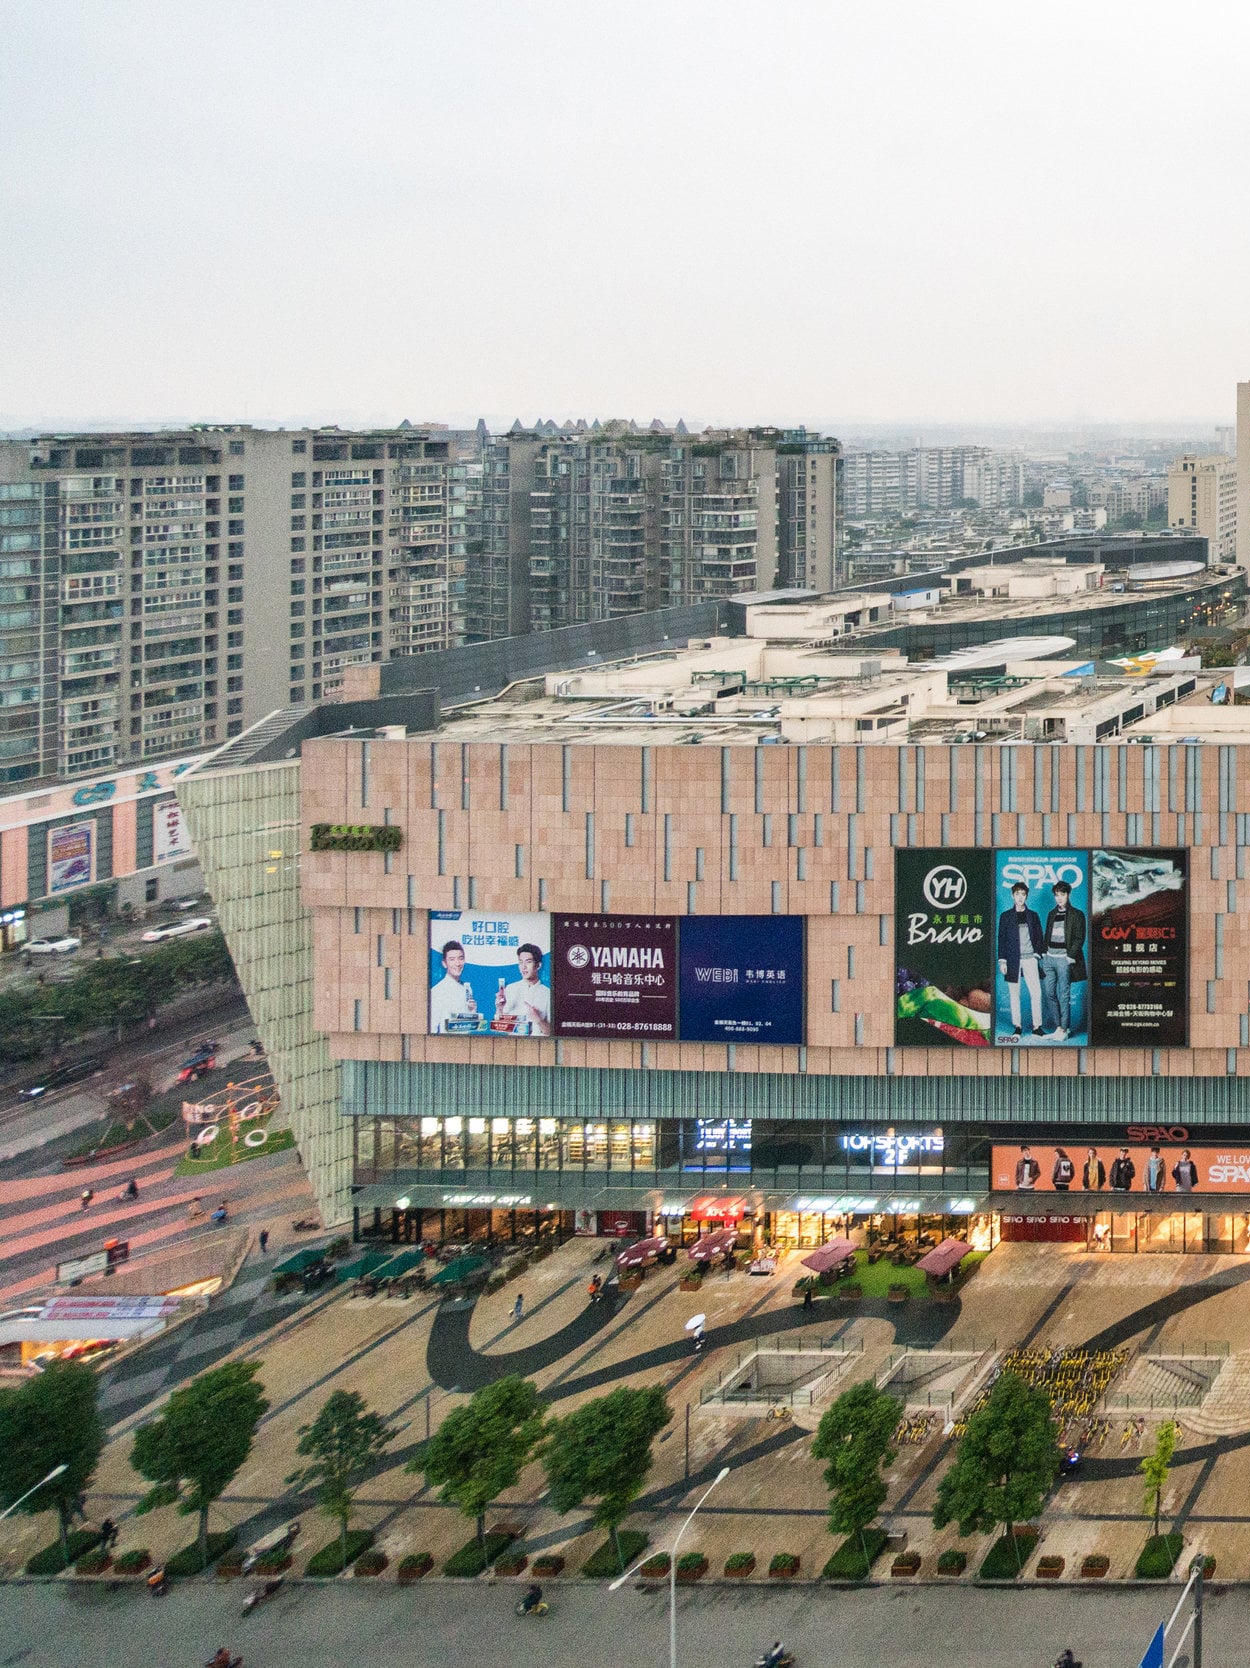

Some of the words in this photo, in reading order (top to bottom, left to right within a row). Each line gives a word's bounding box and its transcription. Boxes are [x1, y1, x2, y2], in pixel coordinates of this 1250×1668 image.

[1002, 864, 1084, 889] SPAO
[931, 877, 963, 899] YH
[471, 920, 511, 934] 好口腔
[907, 912, 984, 945] Bravo
[1101, 926, 1132, 940] CGV
[590, 946, 665, 969] YAMAHA
[591, 972, 665, 986] 雅马哈音乐中心
[745, 969, 786, 980] 韦博英语
[616, 1022, 673, 1032] 028-87618888
[1126, 1125, 1189, 1142] SPAO
[843, 1135, 944, 1150] TOPSPORTS
[884, 1149, 909, 1165] 2F
[1216, 1155, 1232, 1164] WE
[705, 1207, 726, 1217] KFC
